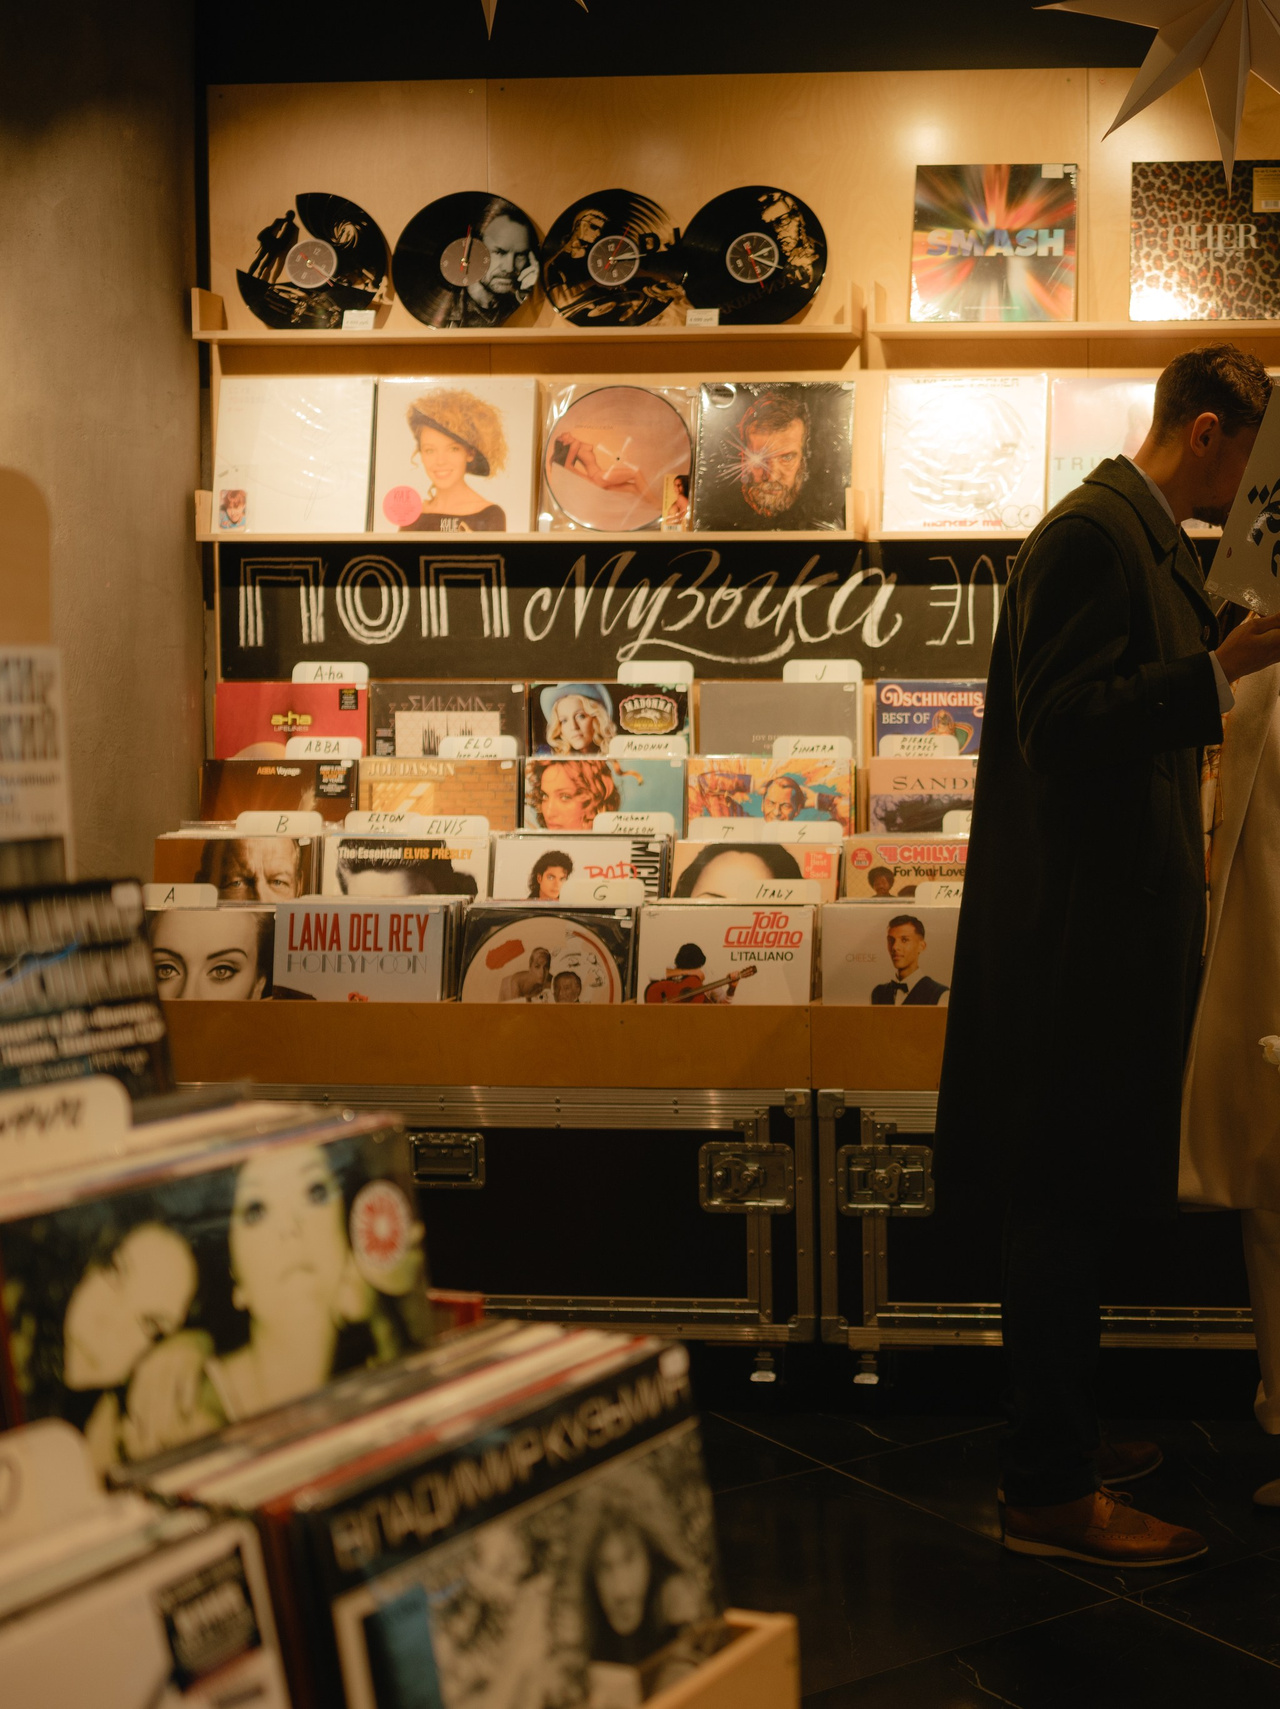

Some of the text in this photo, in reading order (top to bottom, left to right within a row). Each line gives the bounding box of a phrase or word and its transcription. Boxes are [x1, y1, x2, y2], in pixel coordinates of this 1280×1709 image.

[926, 228, 1065, 257] SMASH
[1168, 222, 1259, 250] CHER
[439, 517, 460, 532] KYLIE
[239, 553, 511, 649] ПОП
[624, 698, 672, 714] MADONNA
[271, 710, 312, 726] a-ha
[882, 712, 931, 724] BEST OF
[304, 740, 341, 754] ABBA
[464, 738, 493, 750] ELO
[623, 741, 669, 752] MADONNA
[791, 739, 835, 756] SINATRA
[257, 766, 301, 777] ABBA Voyage
[369, 762, 456, 777] JOE DASSIN
[892, 775, 977, 791] SAND
[276, 815, 289, 834] B
[368, 814, 405, 823] ELTON
[427, 820, 468, 836] ELVIS
[338, 847, 473, 860] The Essential ELVIS PRESLEY
[899, 846, 956, 863] CHILLY
[893, 866, 965, 877] For Your Love
[164, 886, 176, 903] A
[593, 885, 609, 900] G
[756, 884, 794, 900] ITALY
[935, 885, 963, 900] FRA
[288, 913, 430, 952] LANA DEL REY
[723, 925, 804, 948] Cutugno
[286, 953, 428, 975] HONEYMOON
[730, 951, 794, 962] L'ITALIANO
[845, 953, 877, 963] CHEESE
